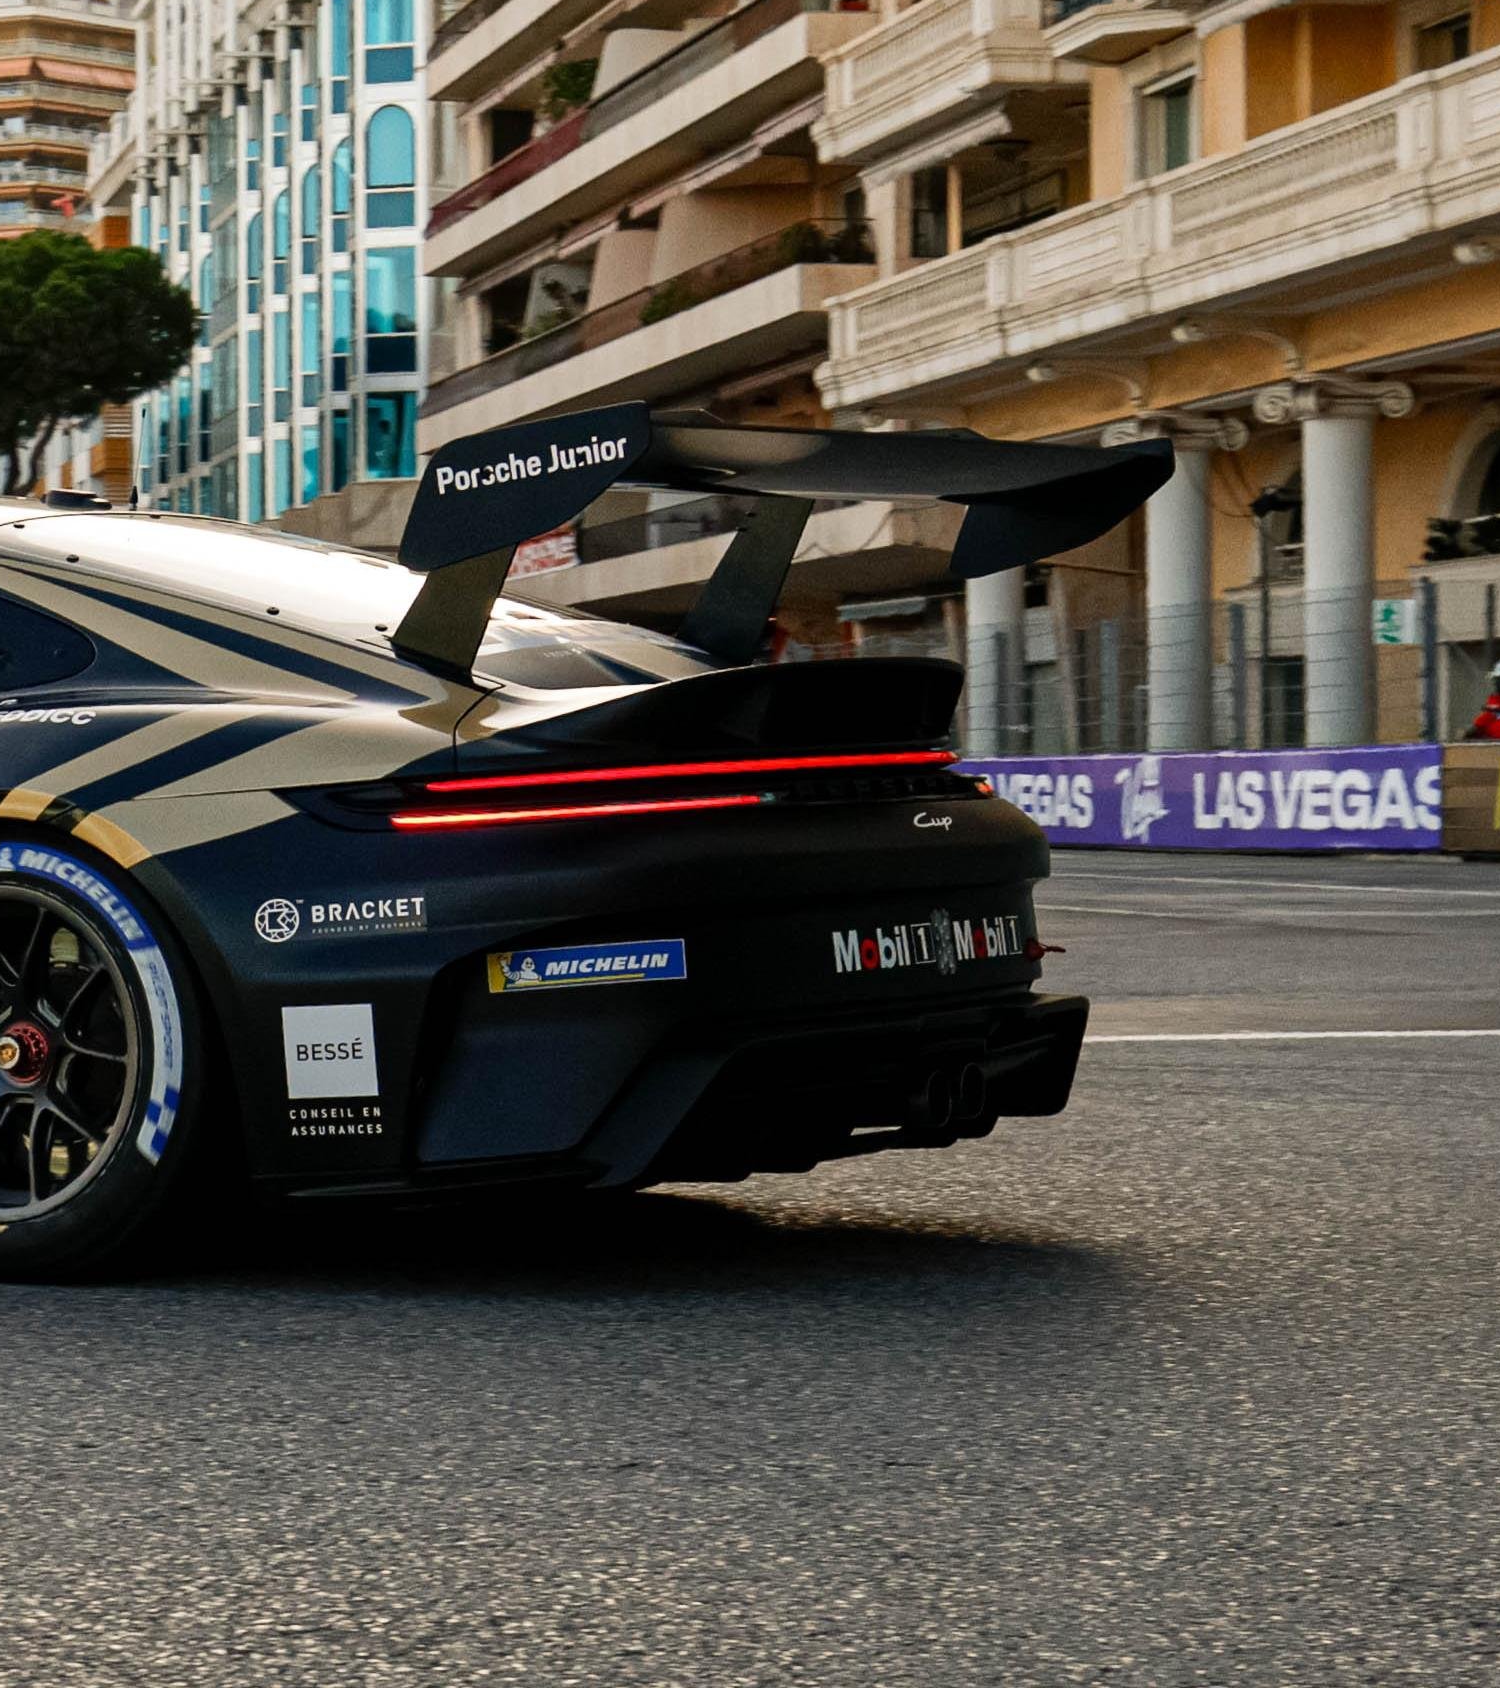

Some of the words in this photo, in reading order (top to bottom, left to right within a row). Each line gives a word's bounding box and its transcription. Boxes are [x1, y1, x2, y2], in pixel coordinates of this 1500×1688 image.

[436, 453, 542, 495] Porsche
[547, 436, 627, 474] Junior
[1192, 770, 1265, 830] LAS
[1270, 765, 1442, 830] VEGAS
[913, 812, 953, 831] Cup
[18, 848, 146, 942] MICHELIN
[311, 897, 425, 923] BRACKET
[831, 924, 912, 974] Mobil
[914, 925, 931, 962] 1
[952, 916, 1008, 961] Mobil
[1007, 917, 1020, 952] 1
[545, 953, 669, 977] MICHELIN
[296, 1037, 364, 1062] BESSÉ
[289, 1107, 355, 1120] CONSEIL
[363, 1107, 381, 1117] EN
[291, 1123, 383, 1137] ASSURANCES
